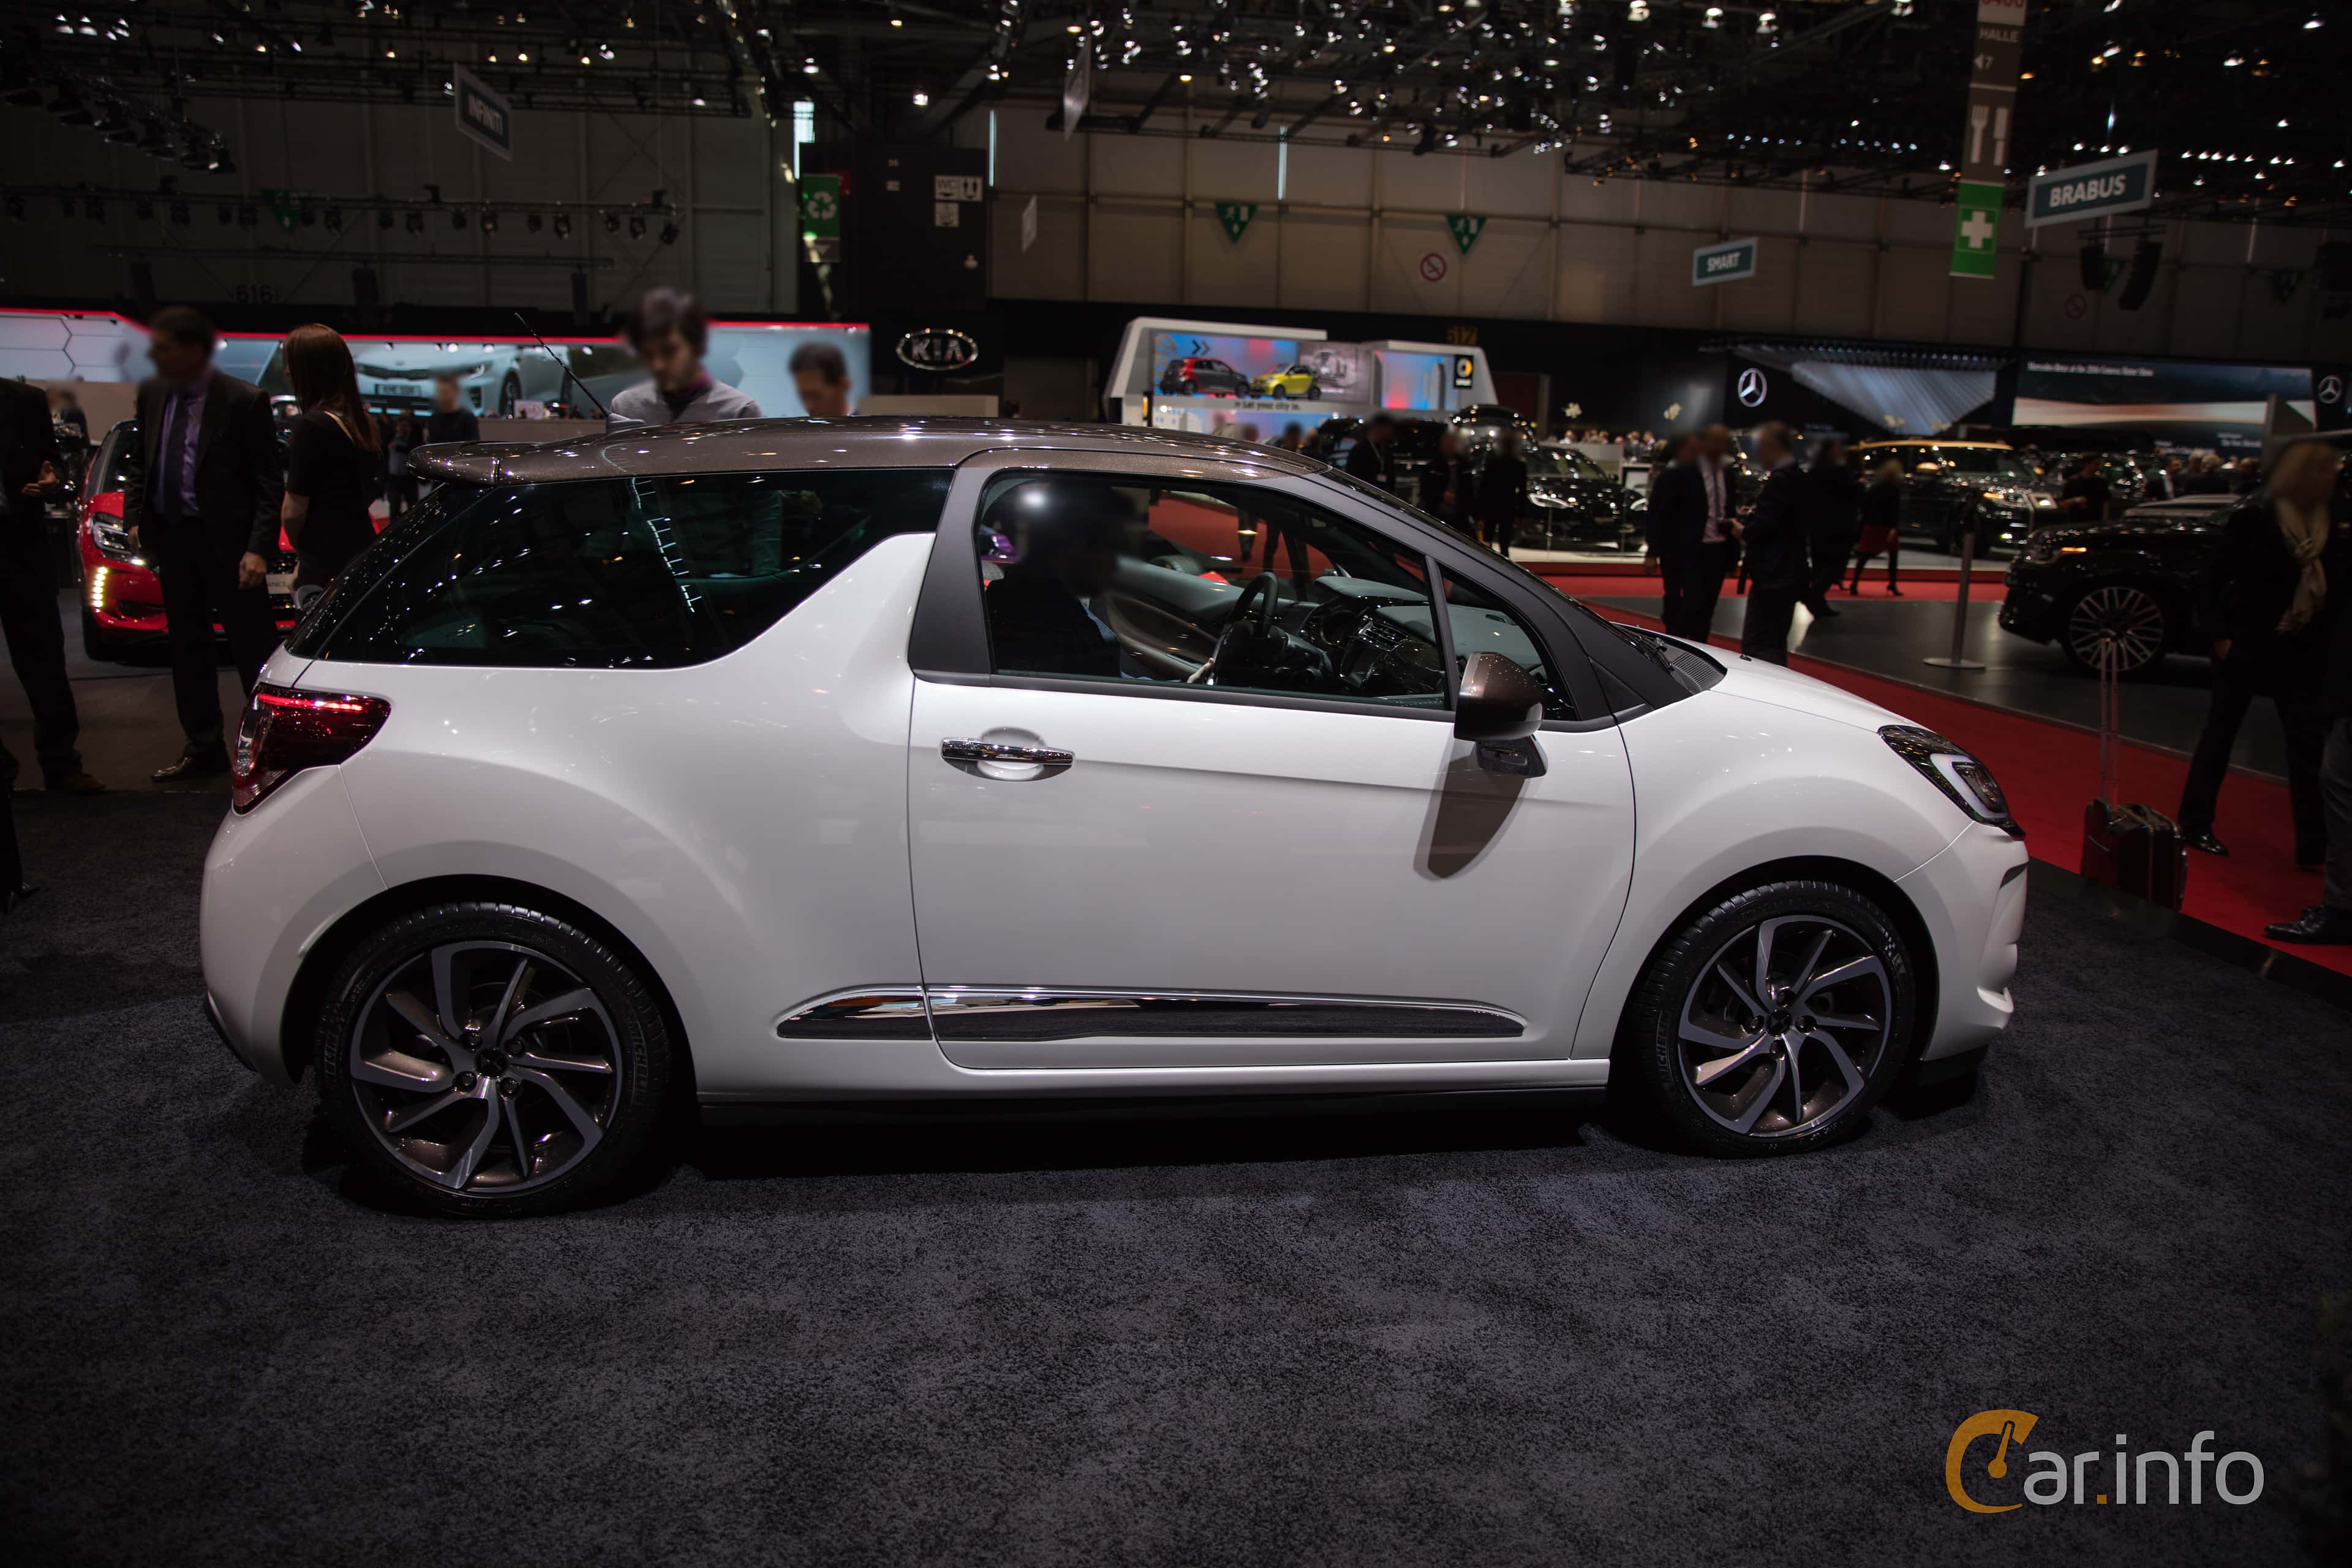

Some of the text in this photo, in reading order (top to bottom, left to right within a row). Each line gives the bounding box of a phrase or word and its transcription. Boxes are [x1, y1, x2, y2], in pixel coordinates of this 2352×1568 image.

[1979, 26, 2019, 43] HALLE
[1985, 55, 1994, 69] 7
[468, 93, 503, 137] INFINITI
[938, 179, 957, 189] WC
[2049, 173, 2127, 208] BRABUS
[1706, 251, 1742, 273] SMART
[911, 337, 965, 363] KIA
